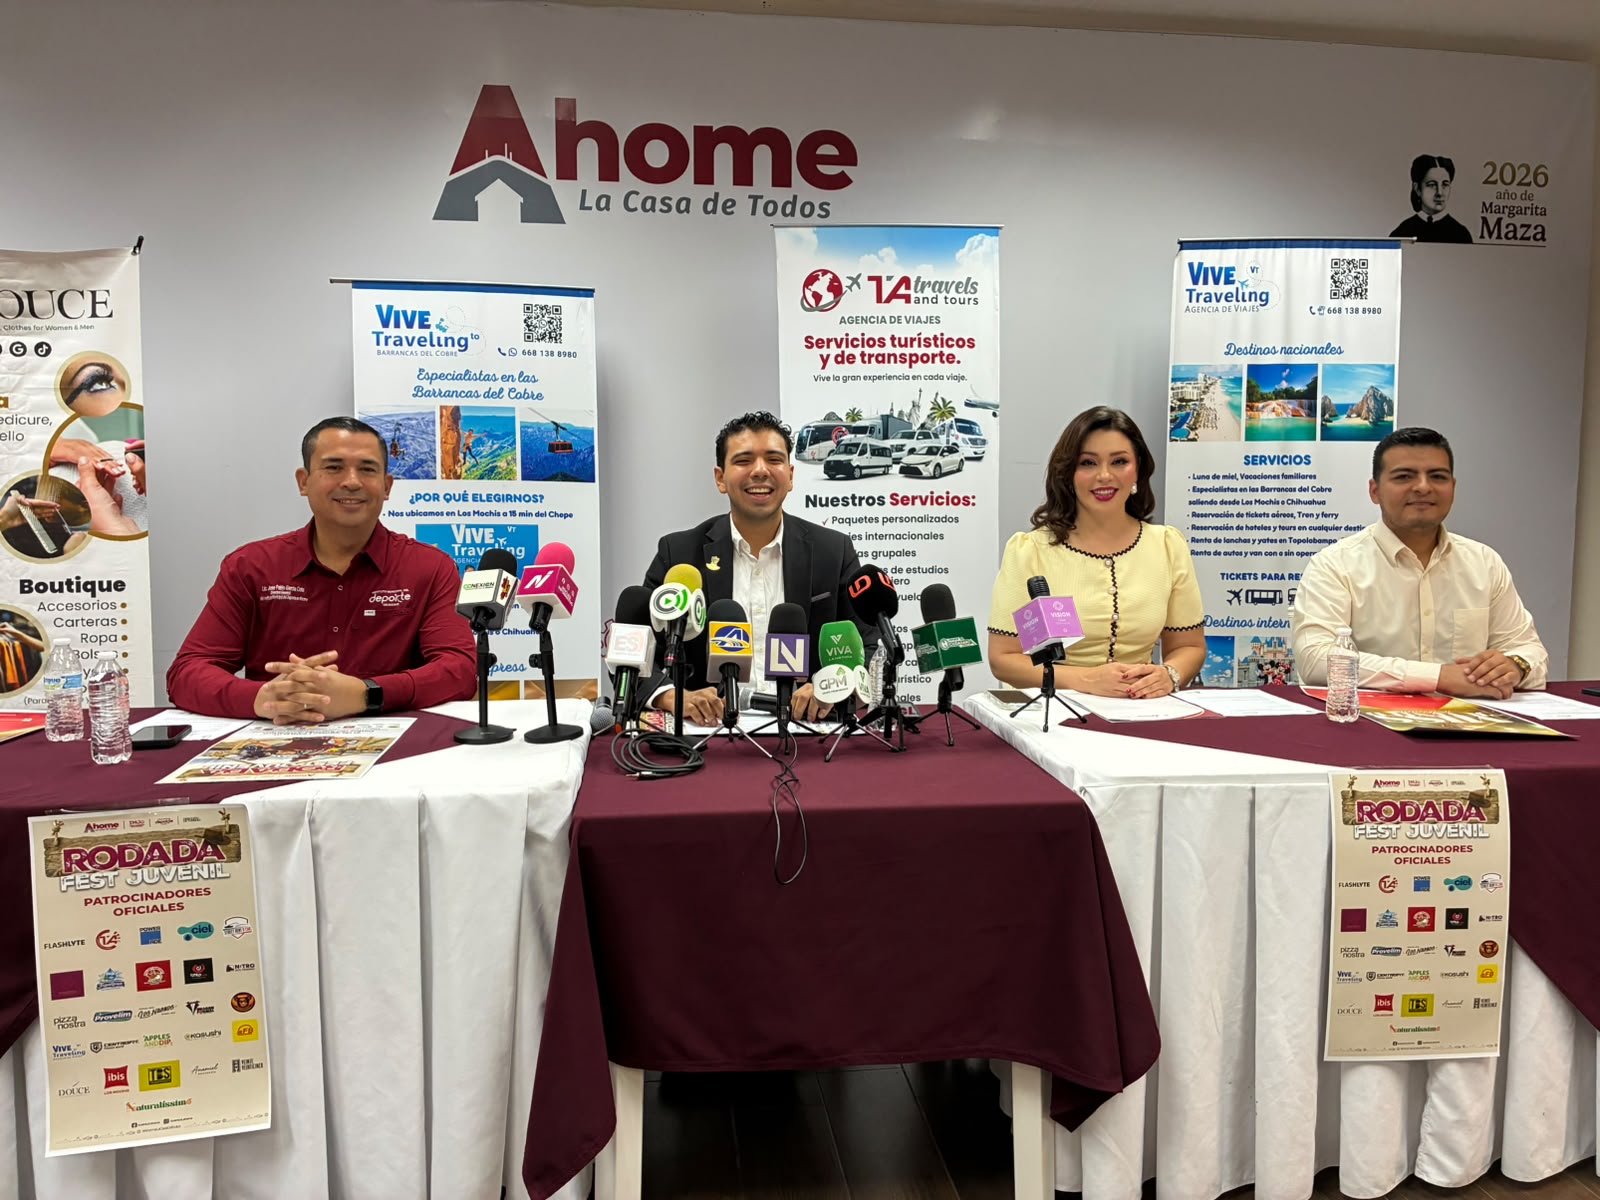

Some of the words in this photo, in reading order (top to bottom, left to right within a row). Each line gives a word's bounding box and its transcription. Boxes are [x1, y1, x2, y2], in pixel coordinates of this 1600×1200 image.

[432, 84, 858, 224] Ahome
[1482, 161, 1548, 188] 2026
[1496, 189, 1517, 200] año
[1520, 190, 1534, 201] de
[579, 188, 610, 212] La
[623, 190, 692, 214] Casa
[702, 192, 736, 216] de
[748, 194, 830, 219] Todos
[1481, 202, 1546, 218] Margarita
[1480, 216, 1546, 242] Maza
[1188, 262, 1236, 285] VIVE
[914, 276, 979, 295] travels
[914, 295, 938, 305] and
[945, 296, 979, 305] tours
[1186, 287, 1269, 307] Traveling
[1184, 305, 1220, 313] AGENCIA
[375, 304, 431, 329] VIVE
[839, 316, 887, 324] AGENCIA
[889, 316, 901, 324] DE
[904, 316, 940, 324] VIAJES
[372, 331, 469, 352] Traveling
[804, 333, 886, 349] Servicios
[890, 332, 975, 349] turísticos
[1224, 343, 1278, 356] Destinos
[1279, 342, 1344, 355] nacionales
[820, 354, 829, 370] y
[834, 351, 856, 364] de
[861, 351, 960, 368] transporte.
[417, 368, 498, 384] Especialistas
[501, 375, 516, 383] en
[518, 371, 538, 383] las
[814, 374, 831, 382] Vive
[842, 375, 861, 383] gran
[863, 374, 909, 382] experiencia
[946, 374, 967, 383] viaje.
[412, 386, 480, 398] Barrancas
[483, 388, 503, 399] del
[508, 388, 544, 400] Cobre
[1243, 455, 1311, 466] SERVICIOS
[1222, 473, 1238, 481] miel,
[1192, 486, 1237, 494] Especialistas
[409, 493, 440, 504] ¿POR
[443, 490, 468, 503] QUÉ
[472, 494, 544, 503] ELEGIRNOS?
[805, 494, 885, 508] Nuestros
[890, 491, 976, 506] Servicios:
[519, 510, 533, 518] min
[535, 510, 546, 518] del
[1271, 512, 1295, 520] aéreos,
[1322, 512, 1339, 520] ferry
[832, 516, 879, 526] Paquetes
[882, 515, 959, 525] personalizados
[452, 524, 494, 544] VIVE
[1309, 524, 1342, 533] cualquier
[865, 532, 944, 540] internacionales
[872, 549, 916, 559] grupales
[891, 566, 903, 574] de
[906, 566, 949, 574] estudios
[1220, 572, 1258, 580] TICKETS
[20, 576, 126, 598] Boutique
[37, 600, 117, 612] Accesorios
[54, 617, 118, 628] Carteras
[1204, 614, 1255, 628] Destinos
[80, 633, 118, 646] Ropa
[826, 646, 852, 656] VIVA
[819, 676, 848, 690] GPM
[1373, 779, 1400, 788] Ahome
[1356, 800, 1486, 822] RODADA
[84, 821, 119, 833] Ahome
[1354, 825, 1400, 840] FEST
[1406, 824, 1490, 839] JUVENIL
[1372, 845, 1473, 853] PATROCINADORES
[63, 839, 226, 873] RODADA
[60, 872, 119, 892] FEST
[126, 863, 230, 886] JUVENIL
[1454, 878, 1472, 886] ciel
[84, 887, 211, 907] PATROCINADORES
[113, 902, 184, 917] OFICIALES
[192, 924, 212, 934] ciel
[44, 939, 85, 949] FLASHLYTE
[1340, 946, 1359, 955] pizza
[1343, 950, 1365, 958] nostra
[1377, 999, 1390, 1007] ibis
[53, 1015, 78, 1026] pizza
[94, 1011, 132, 1022] Provelim
[58, 1020, 86, 1030] nostra
[53, 1044, 72, 1052] VIVE
[108, 1071, 125, 1082] ibis
